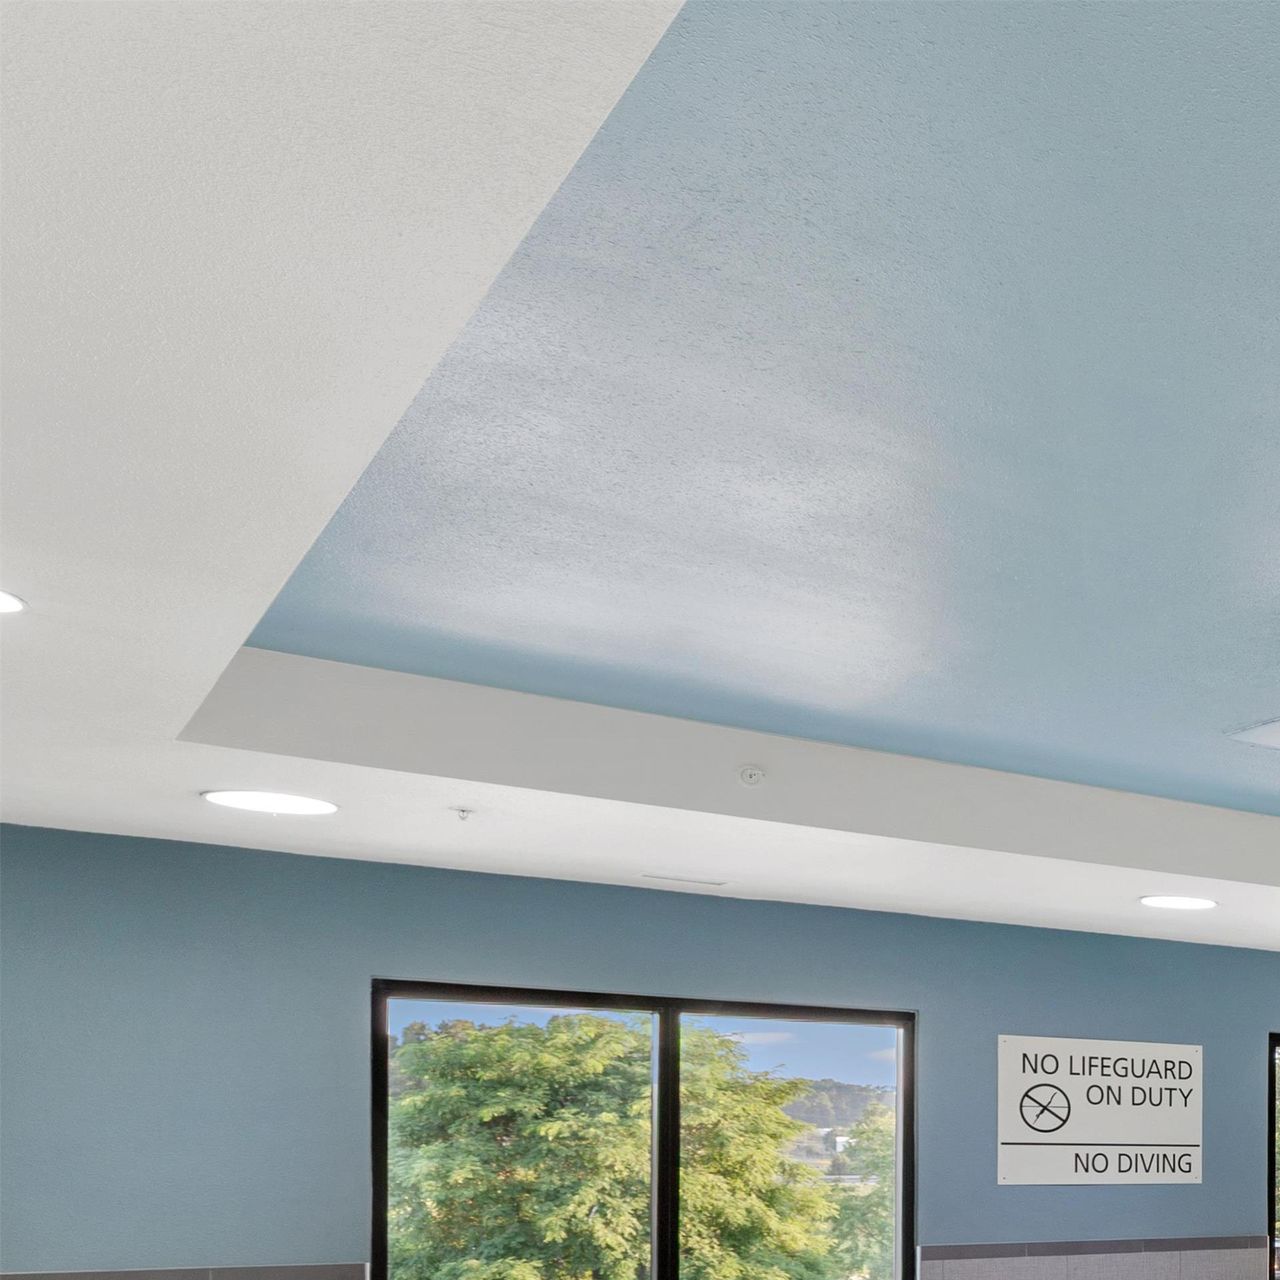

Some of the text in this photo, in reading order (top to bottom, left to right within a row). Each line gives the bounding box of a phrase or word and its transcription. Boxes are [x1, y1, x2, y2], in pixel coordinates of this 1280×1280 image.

[1022, 1053, 1193, 1081] NO LIFEGUARD
[1086, 1084, 1193, 1108] ON DUTY
[1074, 1153, 1192, 1173] NO DIVING
